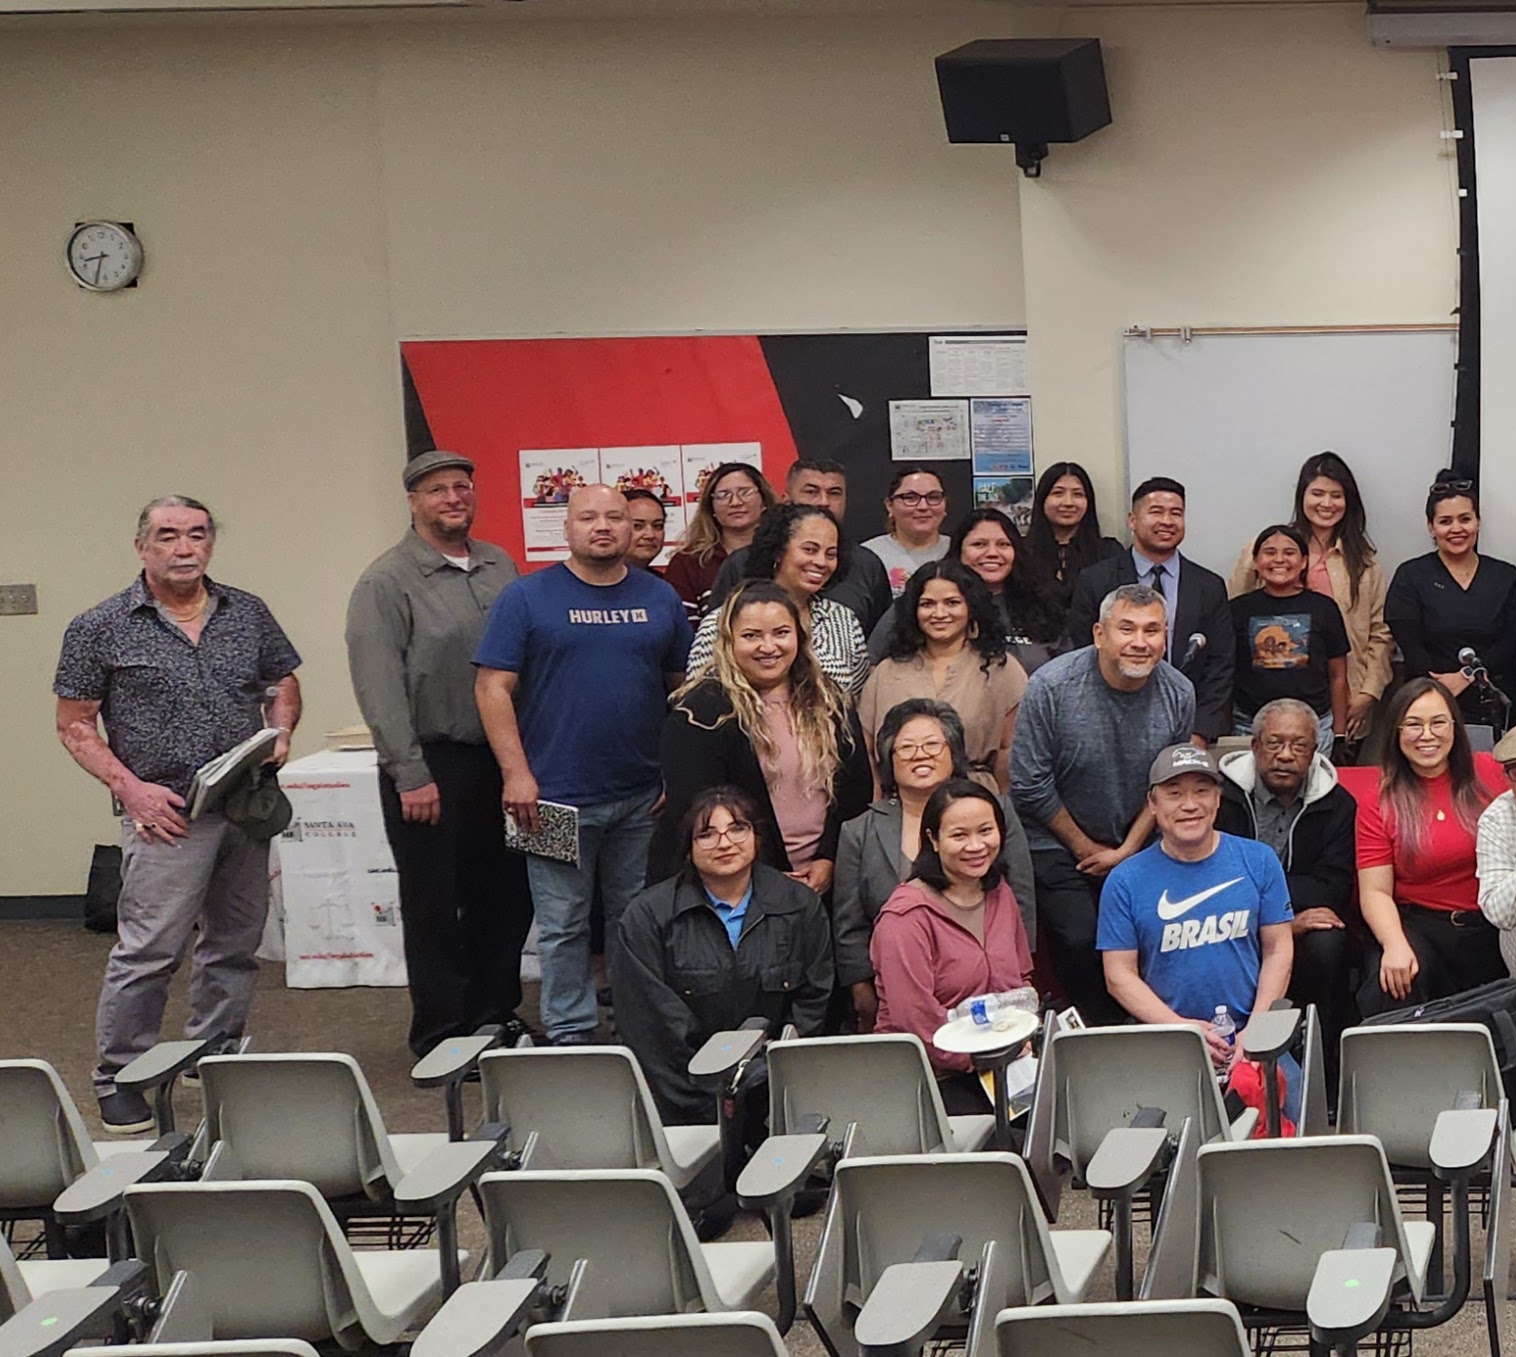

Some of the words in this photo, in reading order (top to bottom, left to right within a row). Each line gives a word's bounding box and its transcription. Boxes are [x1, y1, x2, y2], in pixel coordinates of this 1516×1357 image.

[569, 609, 629, 624] HURLEY
[304, 821, 335, 829] SANTA
[1160, 909, 1251, 953] BRASIL
